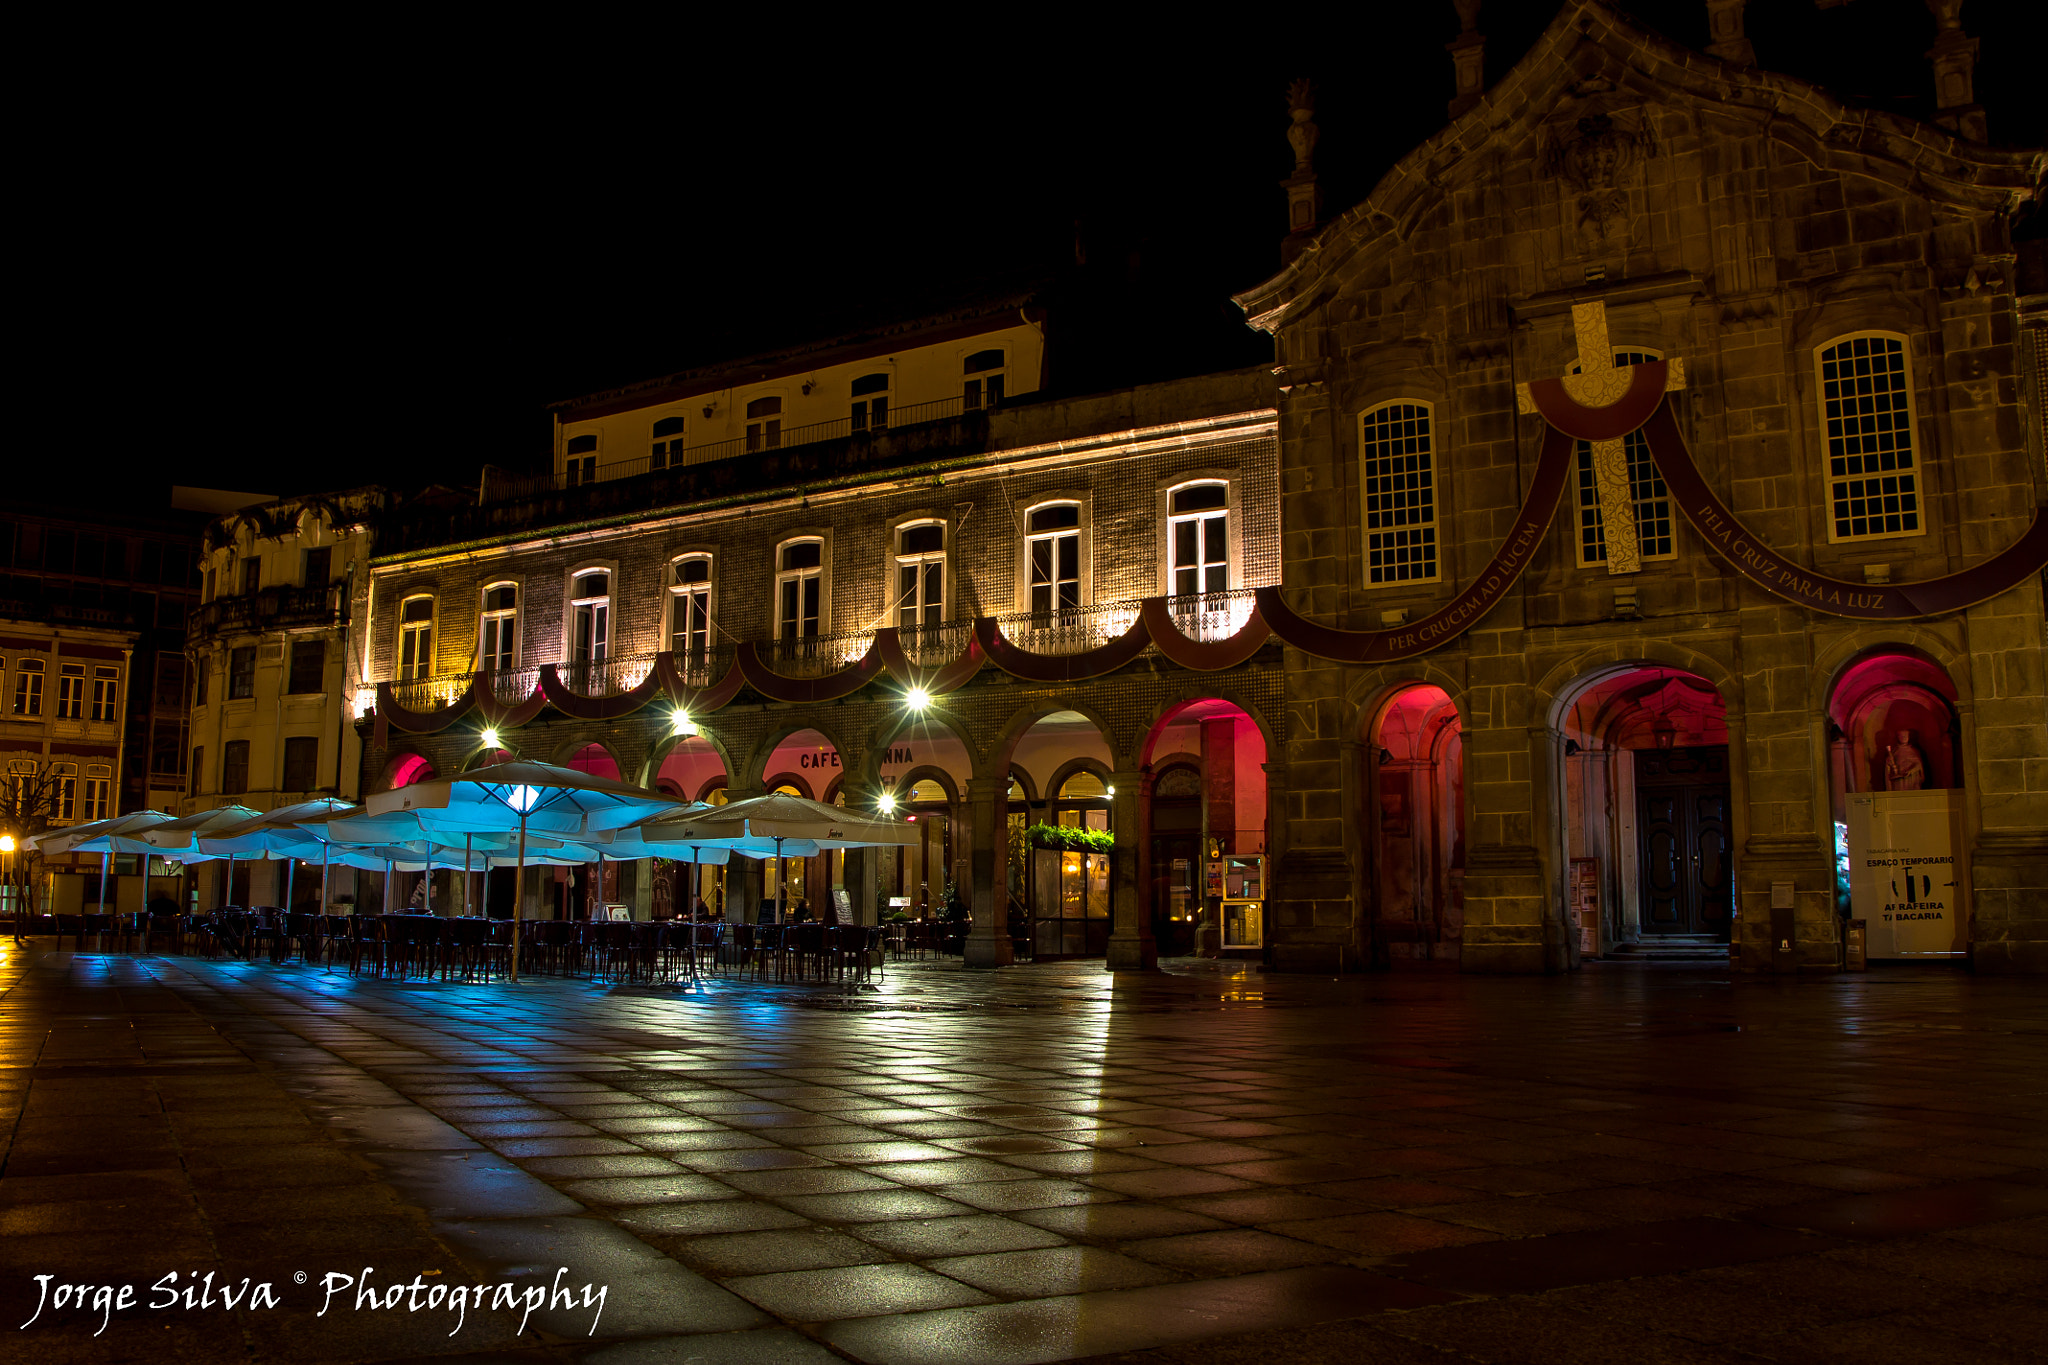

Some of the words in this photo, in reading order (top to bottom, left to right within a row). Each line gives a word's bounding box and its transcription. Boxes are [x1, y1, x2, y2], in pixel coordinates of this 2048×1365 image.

[1388, 632, 1418, 651] PER
[1419, 596, 1483, 642] CRUCEM
[1480, 575, 1501, 601] AD
[1498, 521, 1539, 576] LUCEM
[1698, 505, 1733, 544] PELA
[1732, 539, 1779, 578] CRUZ
[1778, 570, 1824, 601] PARA
[1828, 590, 1841, 605] A
[1847, 592, 1885, 610] LUZ
[800, 751, 840, 769] CAFE
[1867, 858, 1899, 868] ESPAÇO
